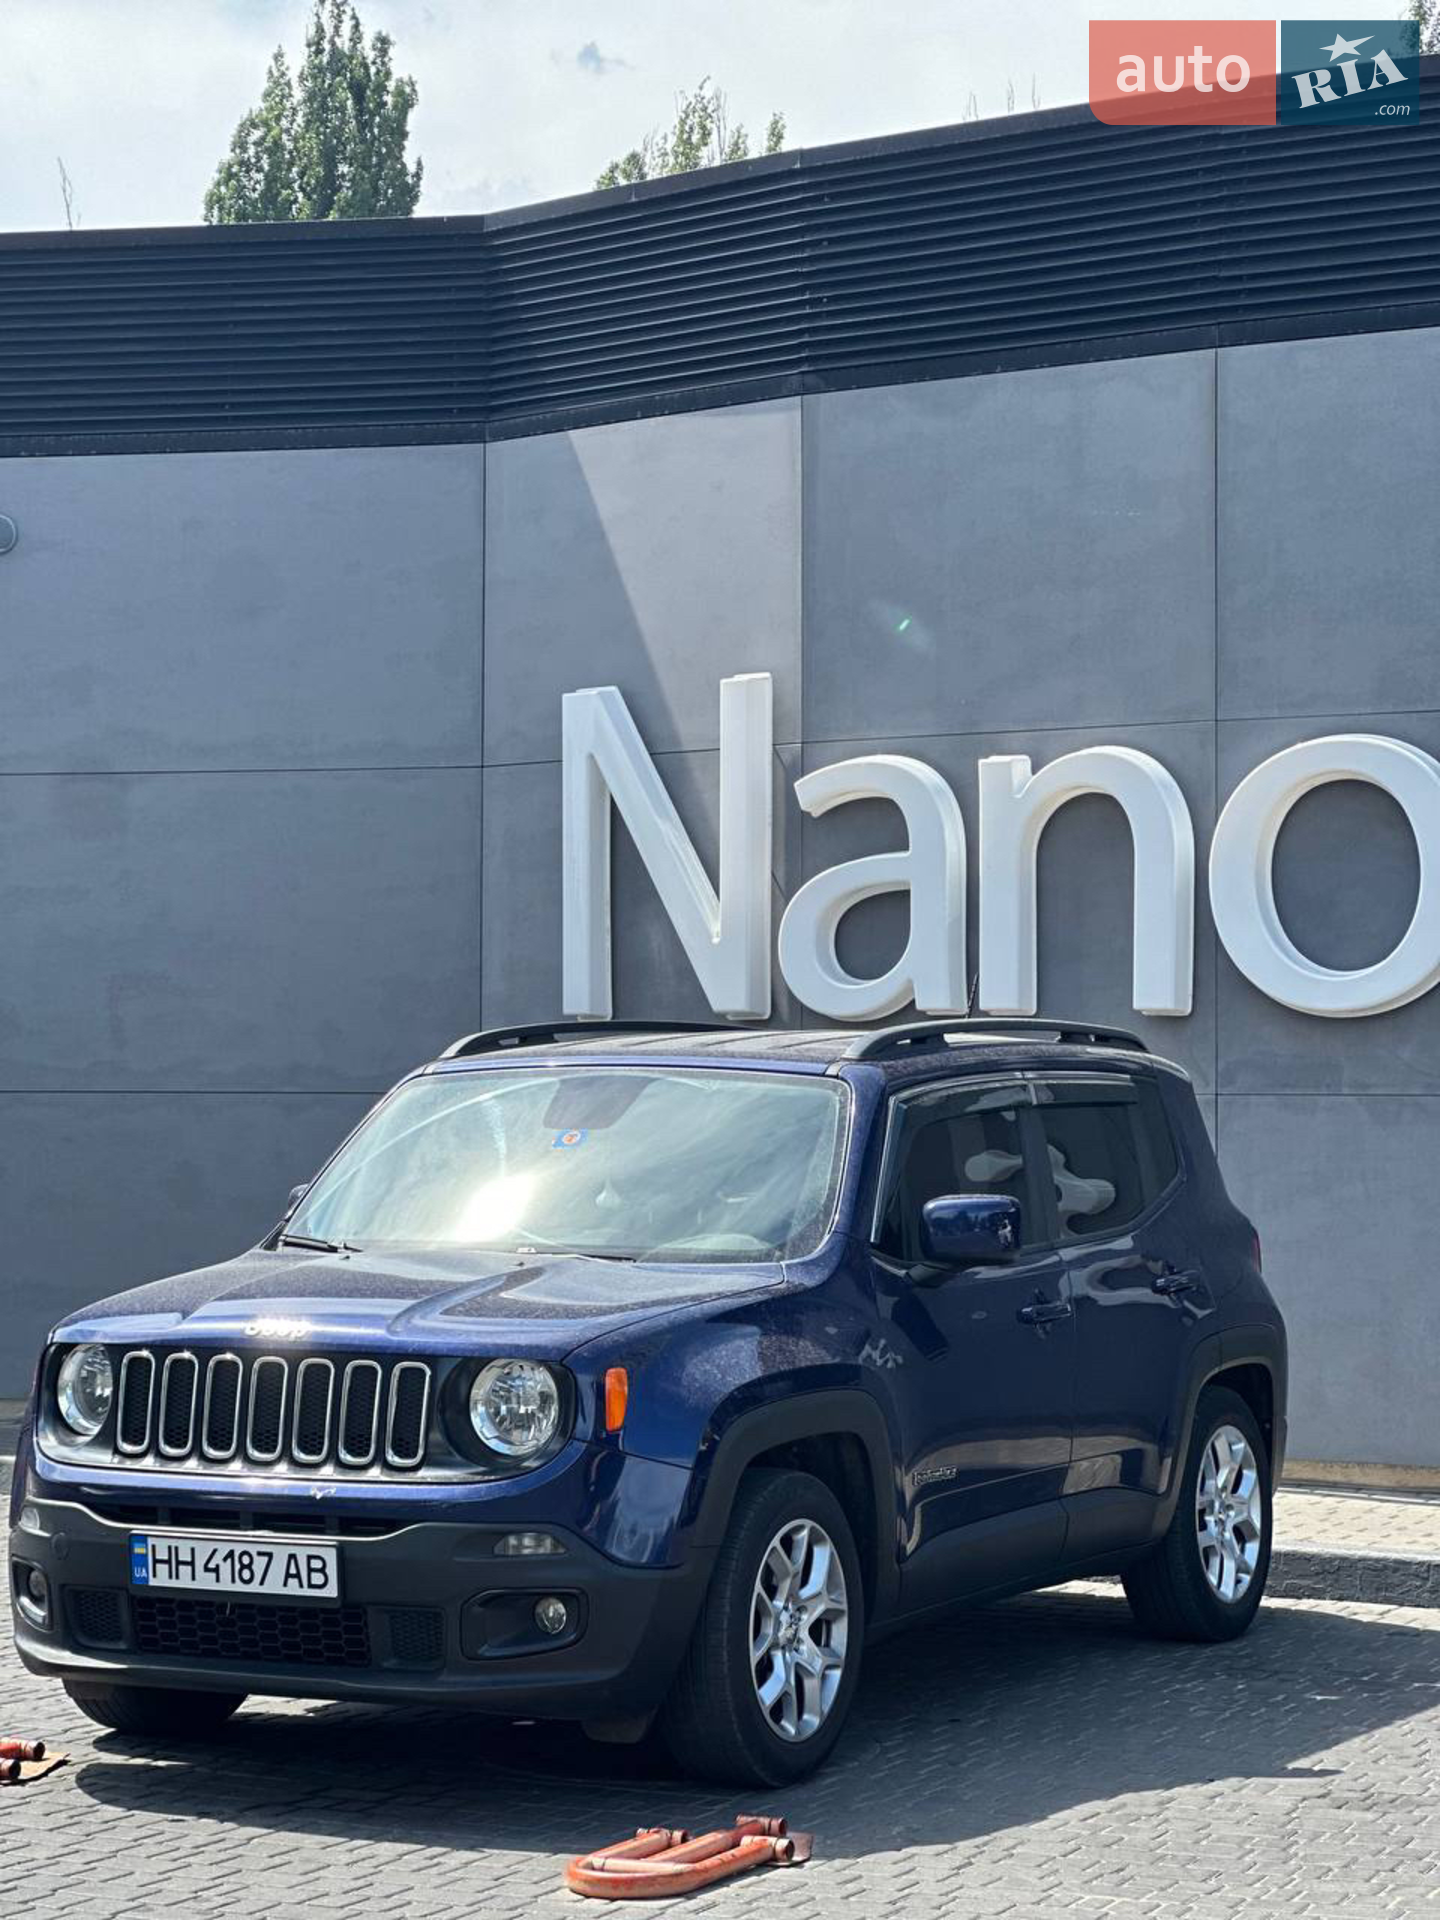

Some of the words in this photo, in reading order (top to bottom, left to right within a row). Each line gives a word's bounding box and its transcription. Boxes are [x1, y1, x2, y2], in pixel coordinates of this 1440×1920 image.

[562, 672, 1440, 1020] Nano
[134, 1567, 147, 1578] UA
[151, 1544, 196, 1581] HH
[203, 1548, 274, 1586] 4187
[282, 1553, 329, 1590] AB
